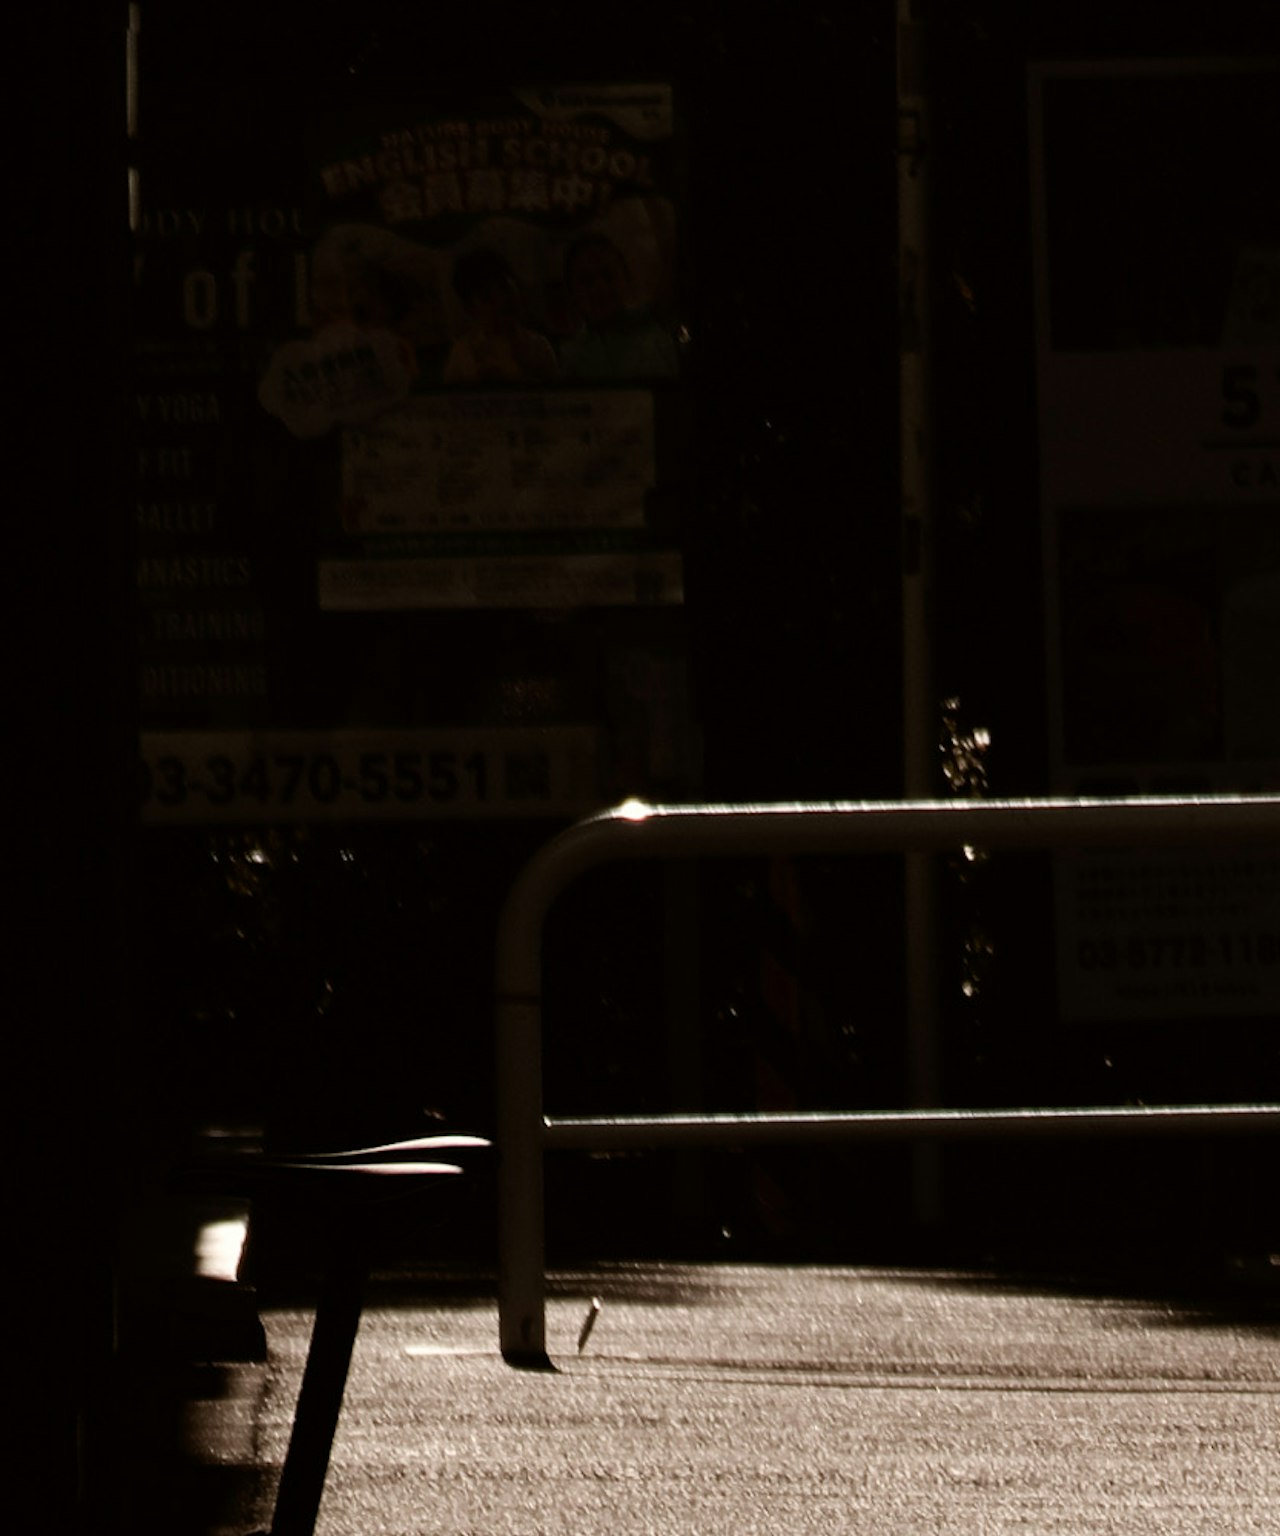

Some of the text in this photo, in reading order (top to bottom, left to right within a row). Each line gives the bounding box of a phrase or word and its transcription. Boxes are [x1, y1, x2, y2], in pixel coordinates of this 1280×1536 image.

[320, 137, 655, 198] ENGLISH SCHOOL
[183, 250, 257, 331] of
[156, 392, 221, 425] YOGA
[151, 611, 268, 641] TRAINING
